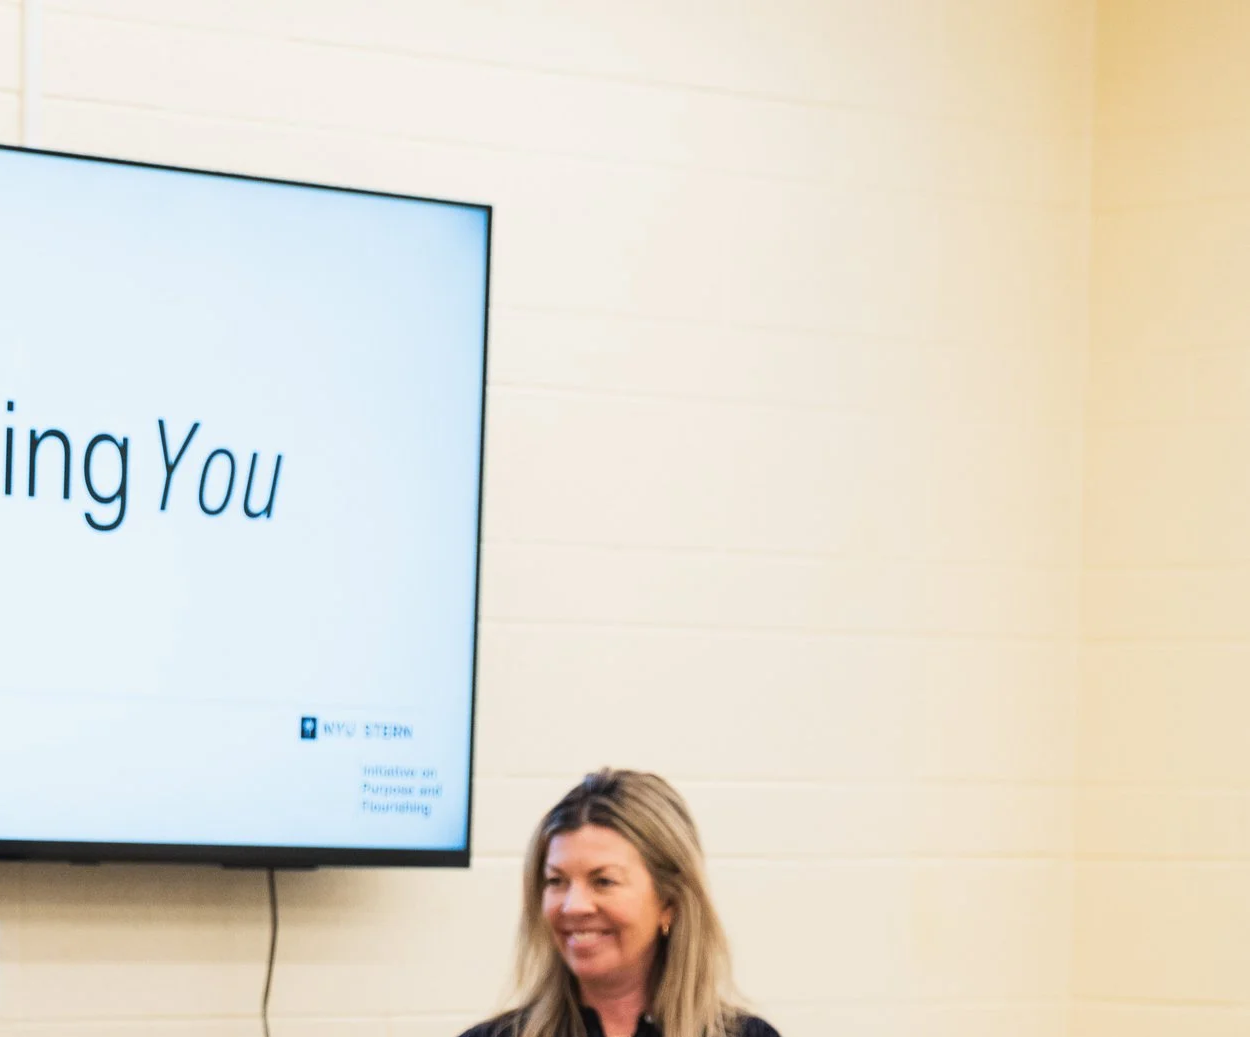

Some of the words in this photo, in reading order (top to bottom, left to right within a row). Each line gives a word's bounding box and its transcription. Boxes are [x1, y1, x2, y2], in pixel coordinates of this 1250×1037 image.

[158, 418, 282, 518] You
[323, 721, 356, 738] NYU
[364, 722, 413, 739] STERN
[363, 765, 416, 777] Initiative
[363, 783, 413, 799] Purpose
[419, 785, 443, 797] and
